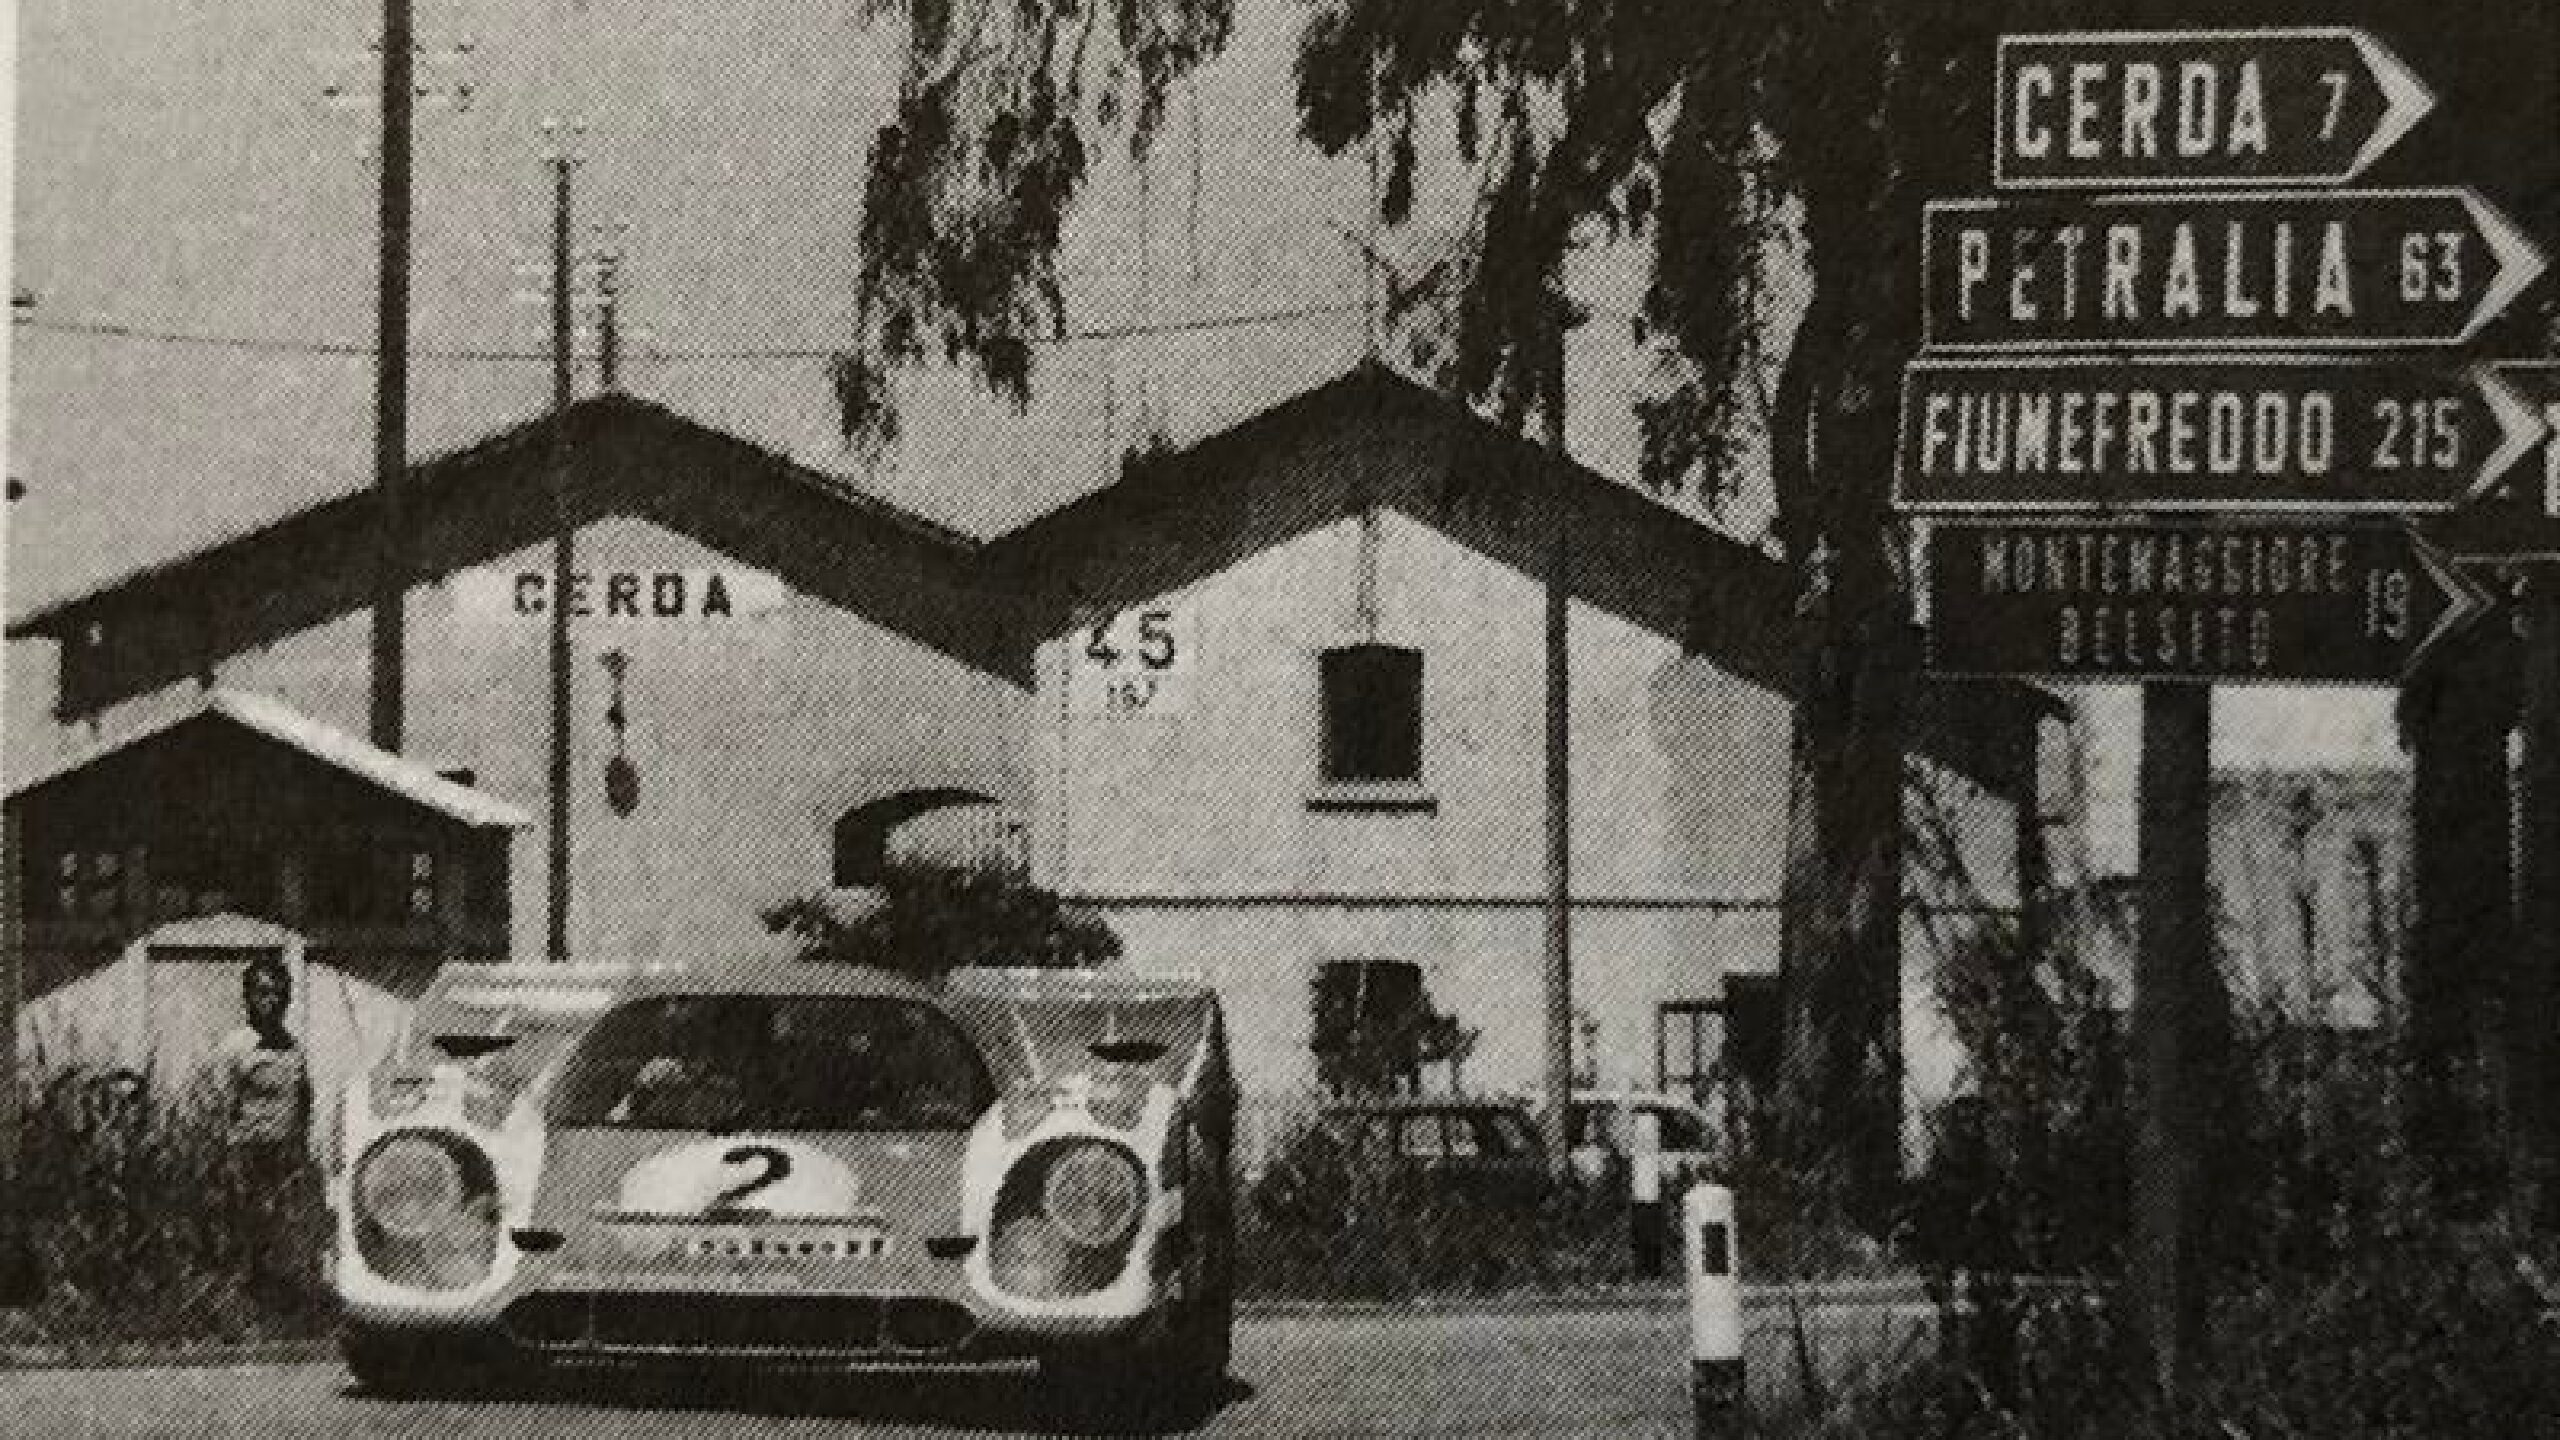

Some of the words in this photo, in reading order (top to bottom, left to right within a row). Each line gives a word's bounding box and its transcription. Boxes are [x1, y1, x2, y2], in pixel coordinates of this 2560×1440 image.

[2015, 59, 2269, 158] CERDA
[2317, 72, 2348, 142] 7
[1957, 220, 2354, 321] PETRALIA
[2400, 231, 2463, 302] 63
[1920, 390, 2334, 476] FIUMEFREDDO
[2371, 398, 2462, 469] 215
[514, 572, 732, 618] CERDA
[2364, 568, 2410, 640] 19
[2058, 606, 2271, 667] BELSITO
[703, 1144, 792, 1224] 2
